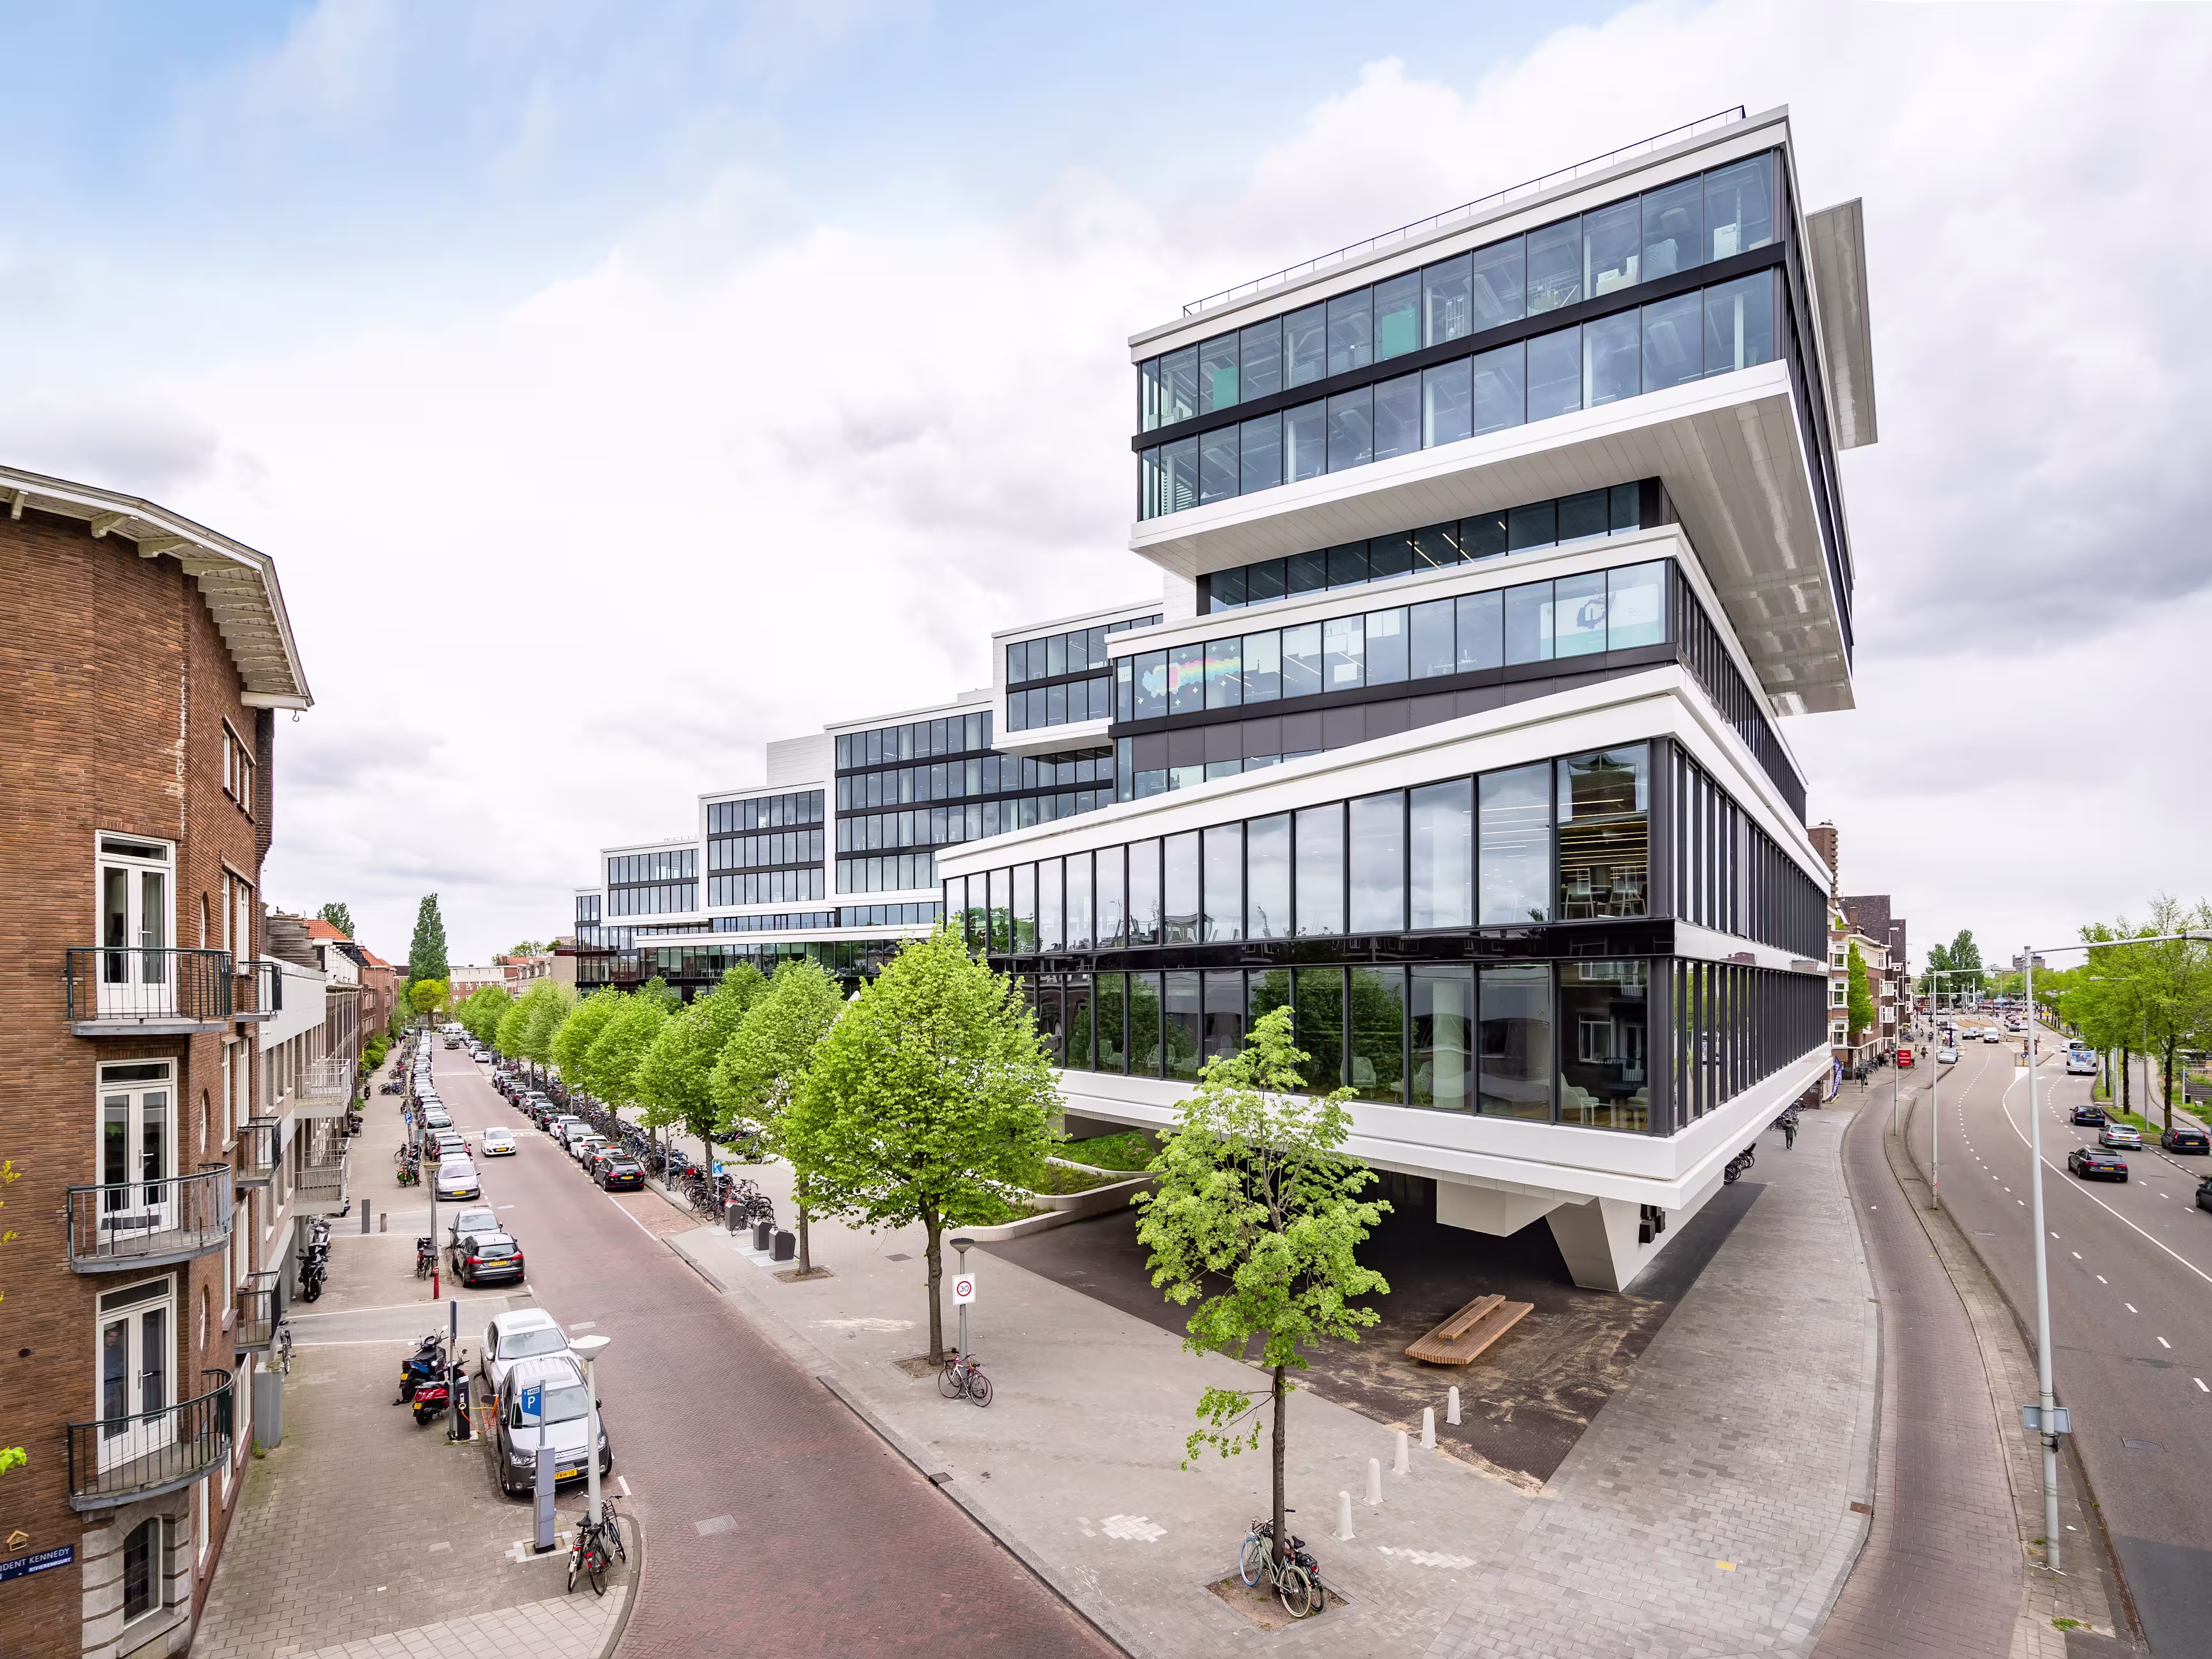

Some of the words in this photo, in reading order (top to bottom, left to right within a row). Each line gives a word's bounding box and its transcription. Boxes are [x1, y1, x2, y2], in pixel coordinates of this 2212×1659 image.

[528, 1396, 536, 1409] P
[555, 1471, 575, 1479] -TRH-10
[29, 1547, 70, 1564] KENNEDY
[29, 1557, 71, 1573] RIVIERENBUURT
